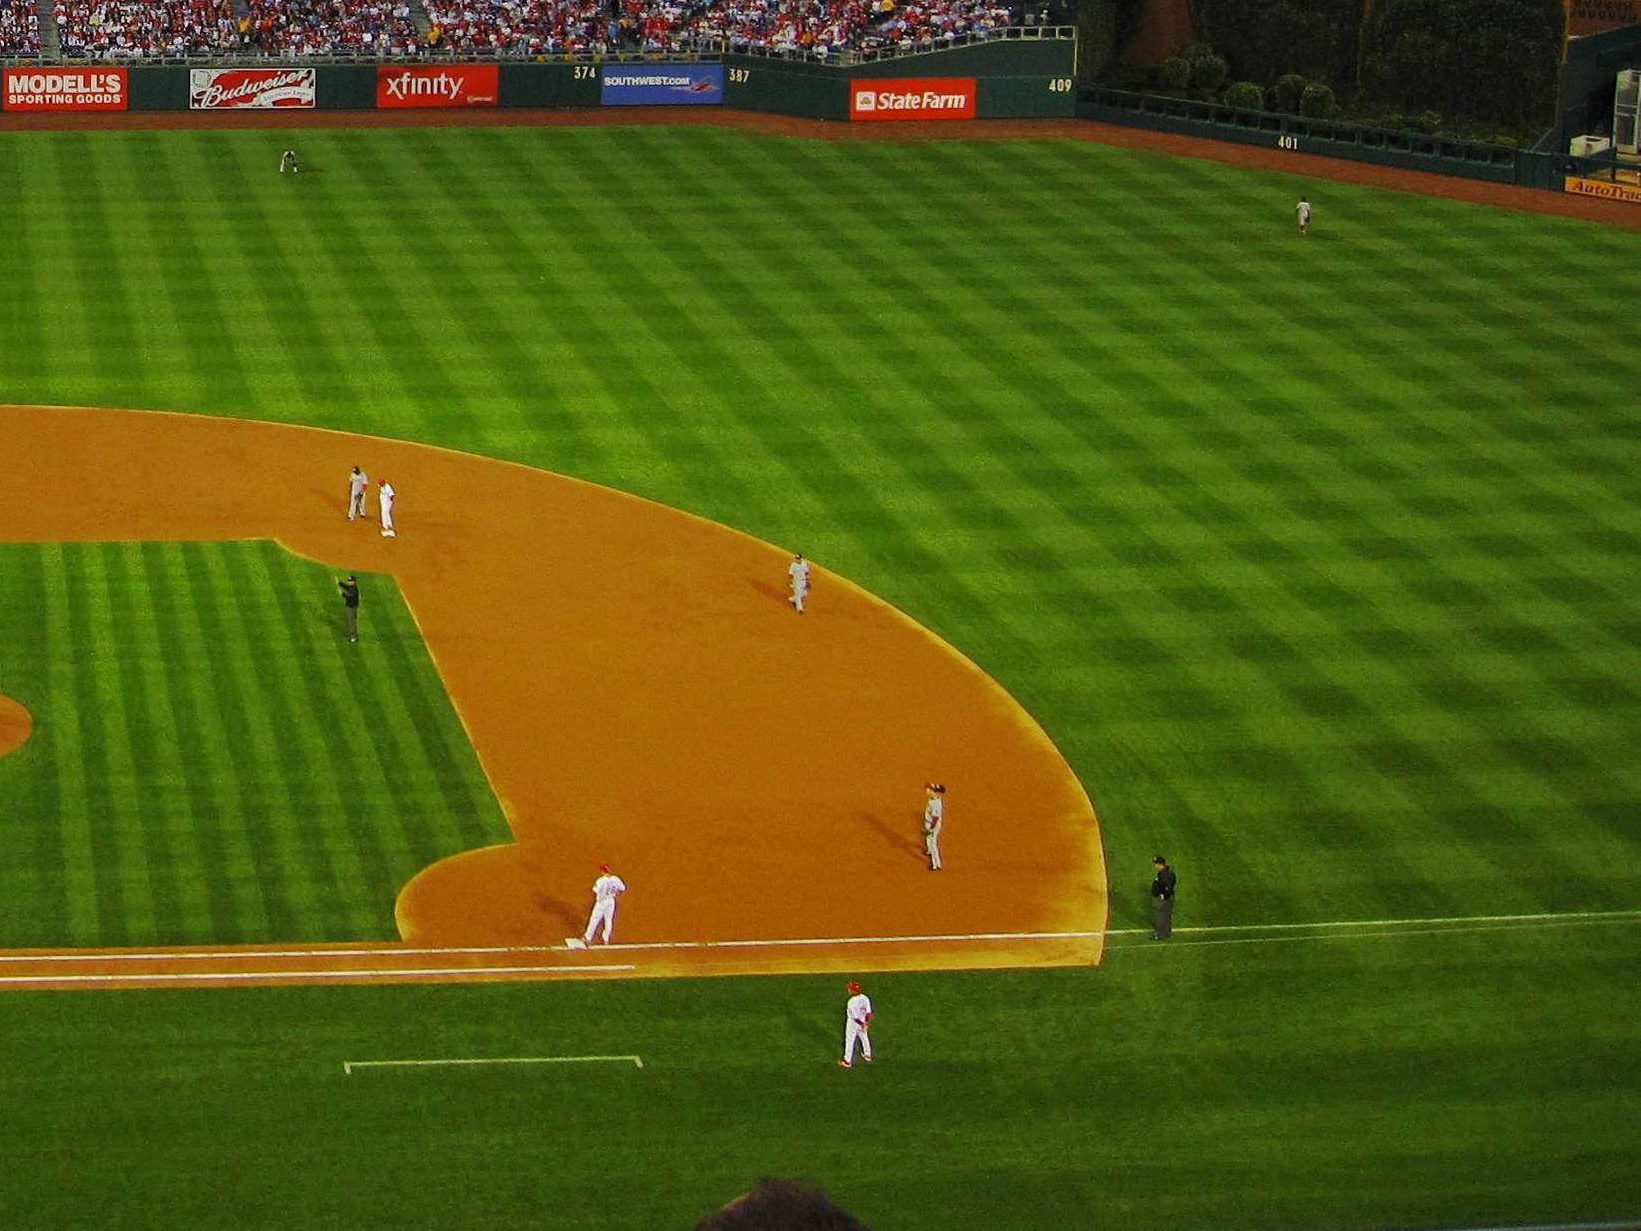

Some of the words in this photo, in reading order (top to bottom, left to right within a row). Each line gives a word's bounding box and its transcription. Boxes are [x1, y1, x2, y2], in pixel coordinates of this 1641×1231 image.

[573, 66, 596, 80] 374
[729, 69, 750, 83] 387
[8, 74, 121, 93] MODELL'S
[194, 69, 309, 108] Budweiser
[386, 72, 464, 100] xfinity
[1048, 79, 1072, 92] 409
[8, 95, 73, 105] SPORTING
[76, 94, 121, 104] GOODS
[877, 92, 920, 110] State
[922, 92, 966, 110] Farm
[1278, 135, 1298, 150] 401
